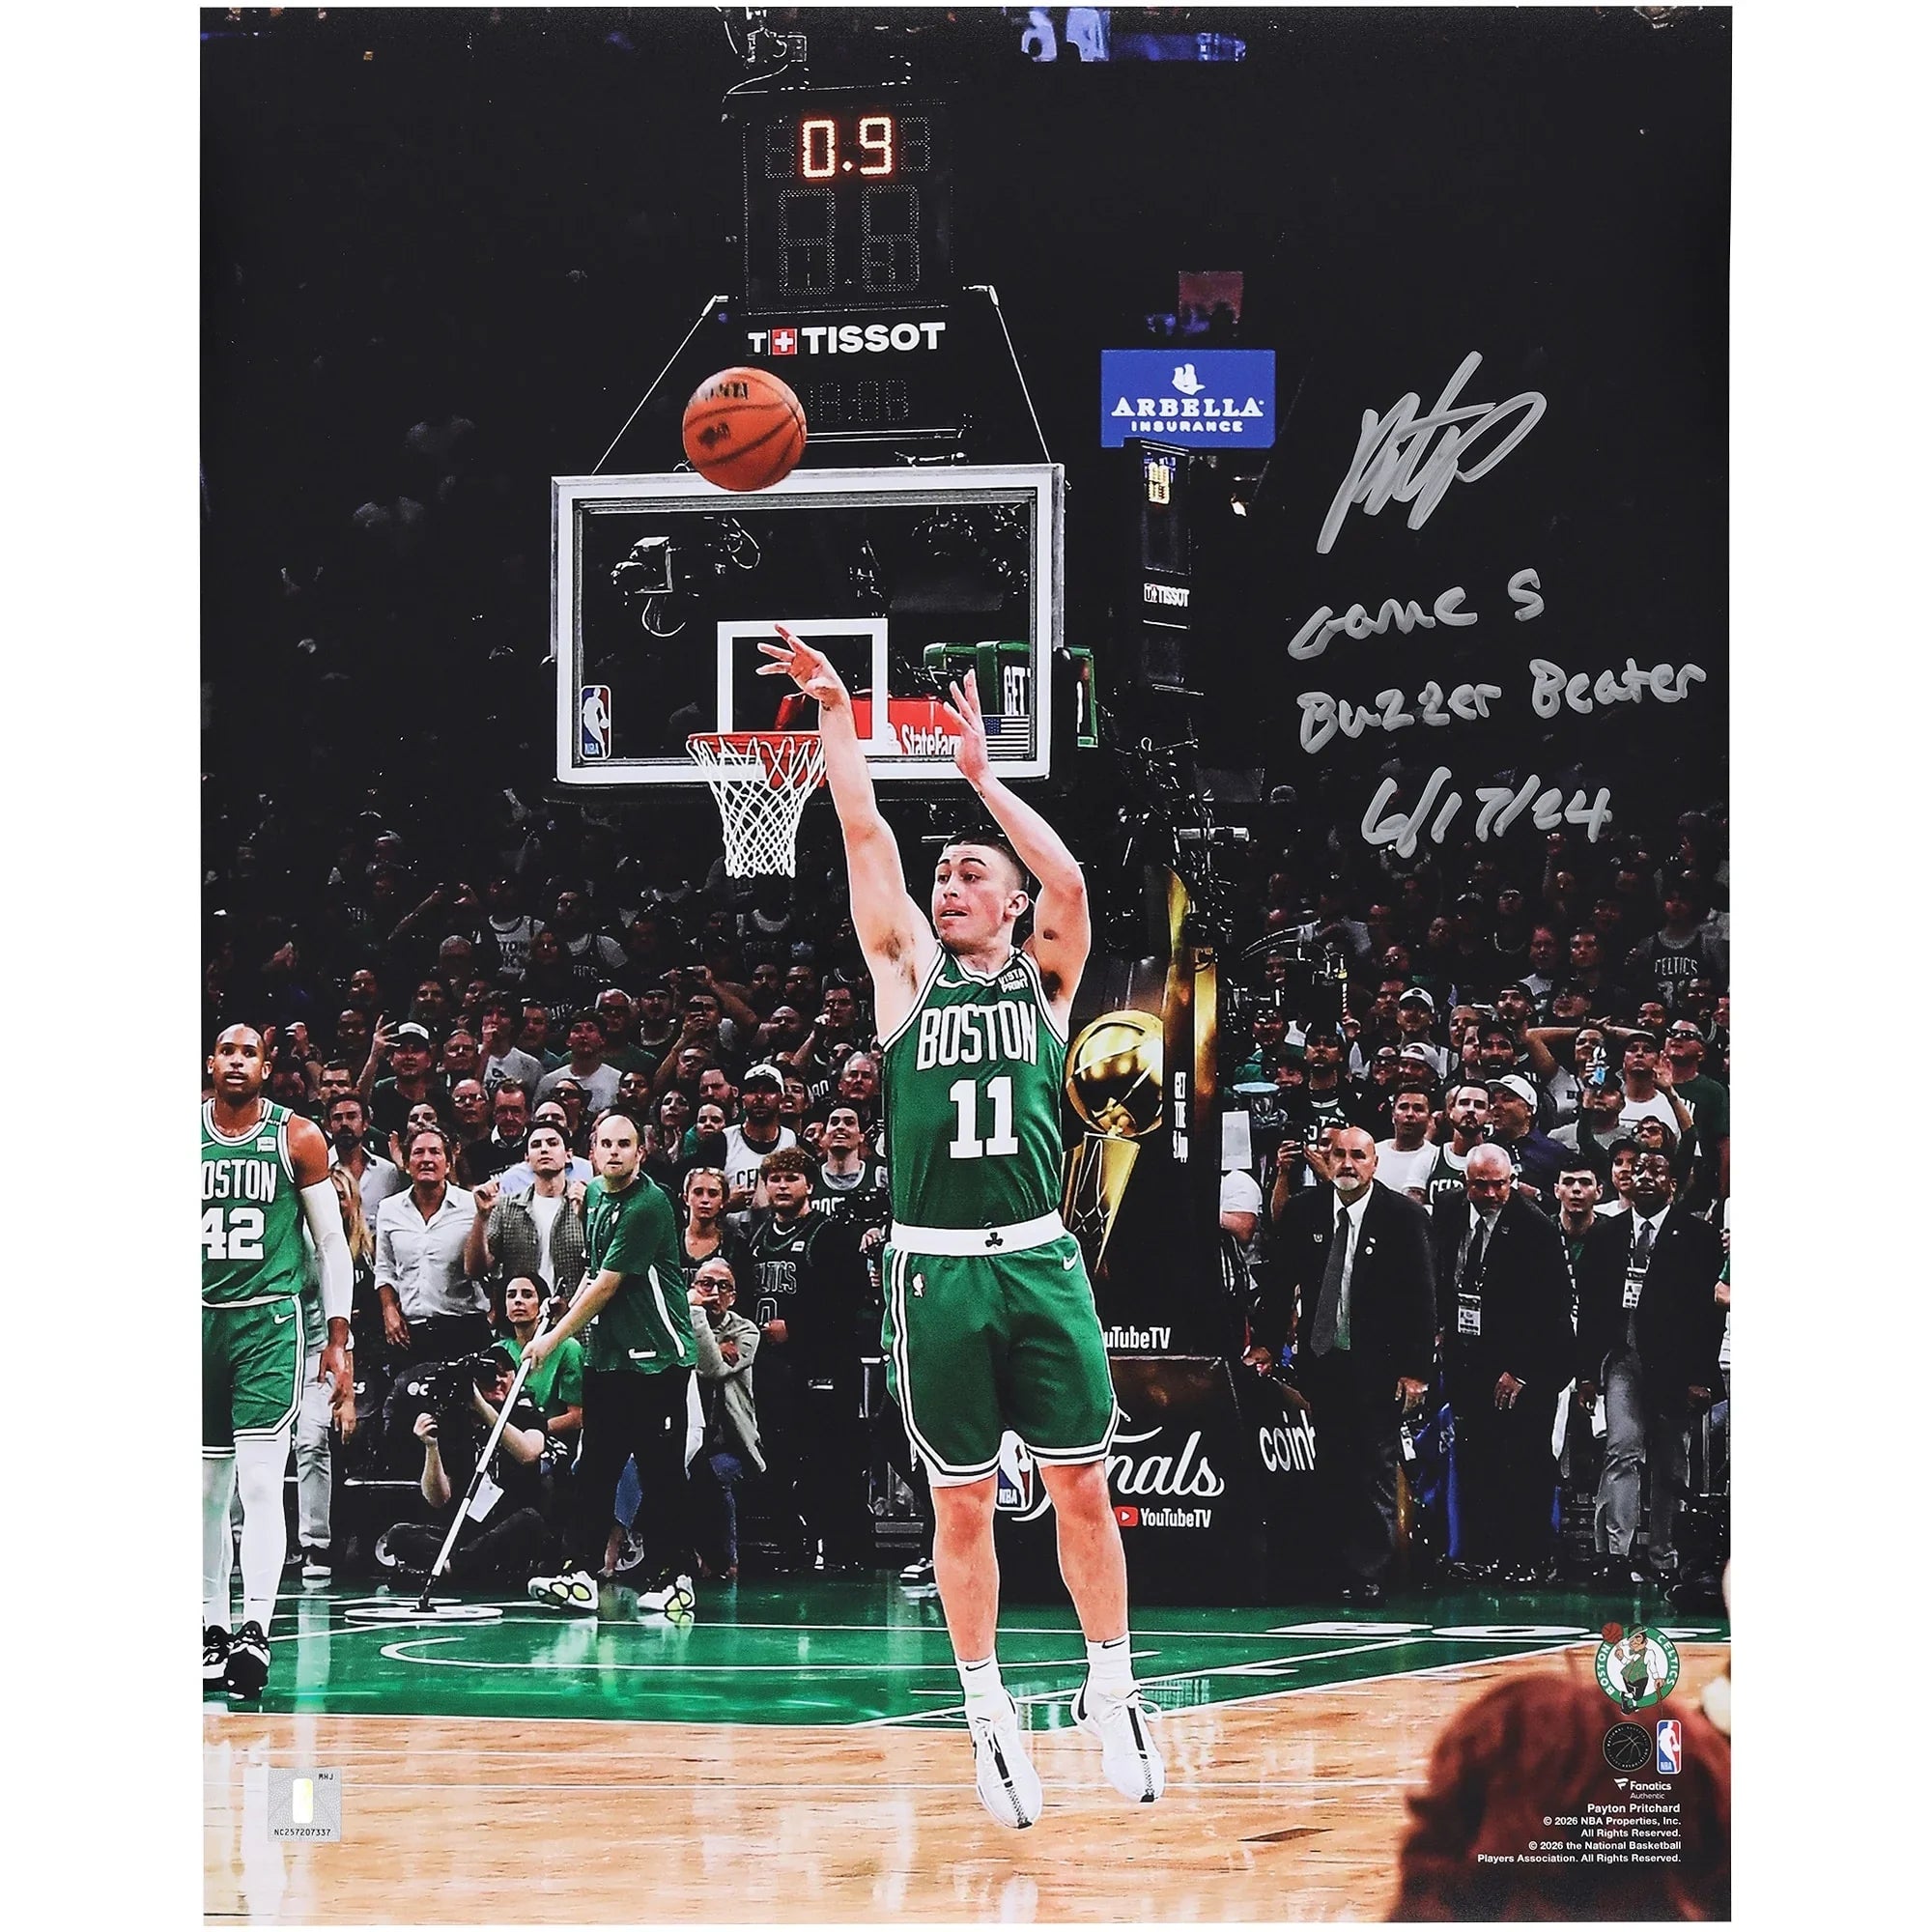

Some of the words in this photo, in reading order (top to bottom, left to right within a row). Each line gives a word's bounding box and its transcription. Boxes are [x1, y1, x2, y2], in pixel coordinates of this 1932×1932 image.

[802, 117, 893, 178] 0.9
[801, 323, 946, 355] TISSOT
[1112, 397, 1264, 417] ARBELLA
[1131, 421, 1243, 432] INSURANCE
[1158, 585, 1189, 607] TISSOT
[1529, 658, 1706, 718] Beater
[1361, 767, 1612, 859] 6/17/24
[998, 968, 1026, 984] VISTA
[917, 1000, 1037, 1071] BOSTON
[950, 1075, 1019, 1159] 11
[202, 1159, 277, 1204] OSTON
[202, 1208, 265, 1260] 42
[1105, 1325, 1171, 1350] uTubeTV
[1106, 1427, 1225, 1497] nals
